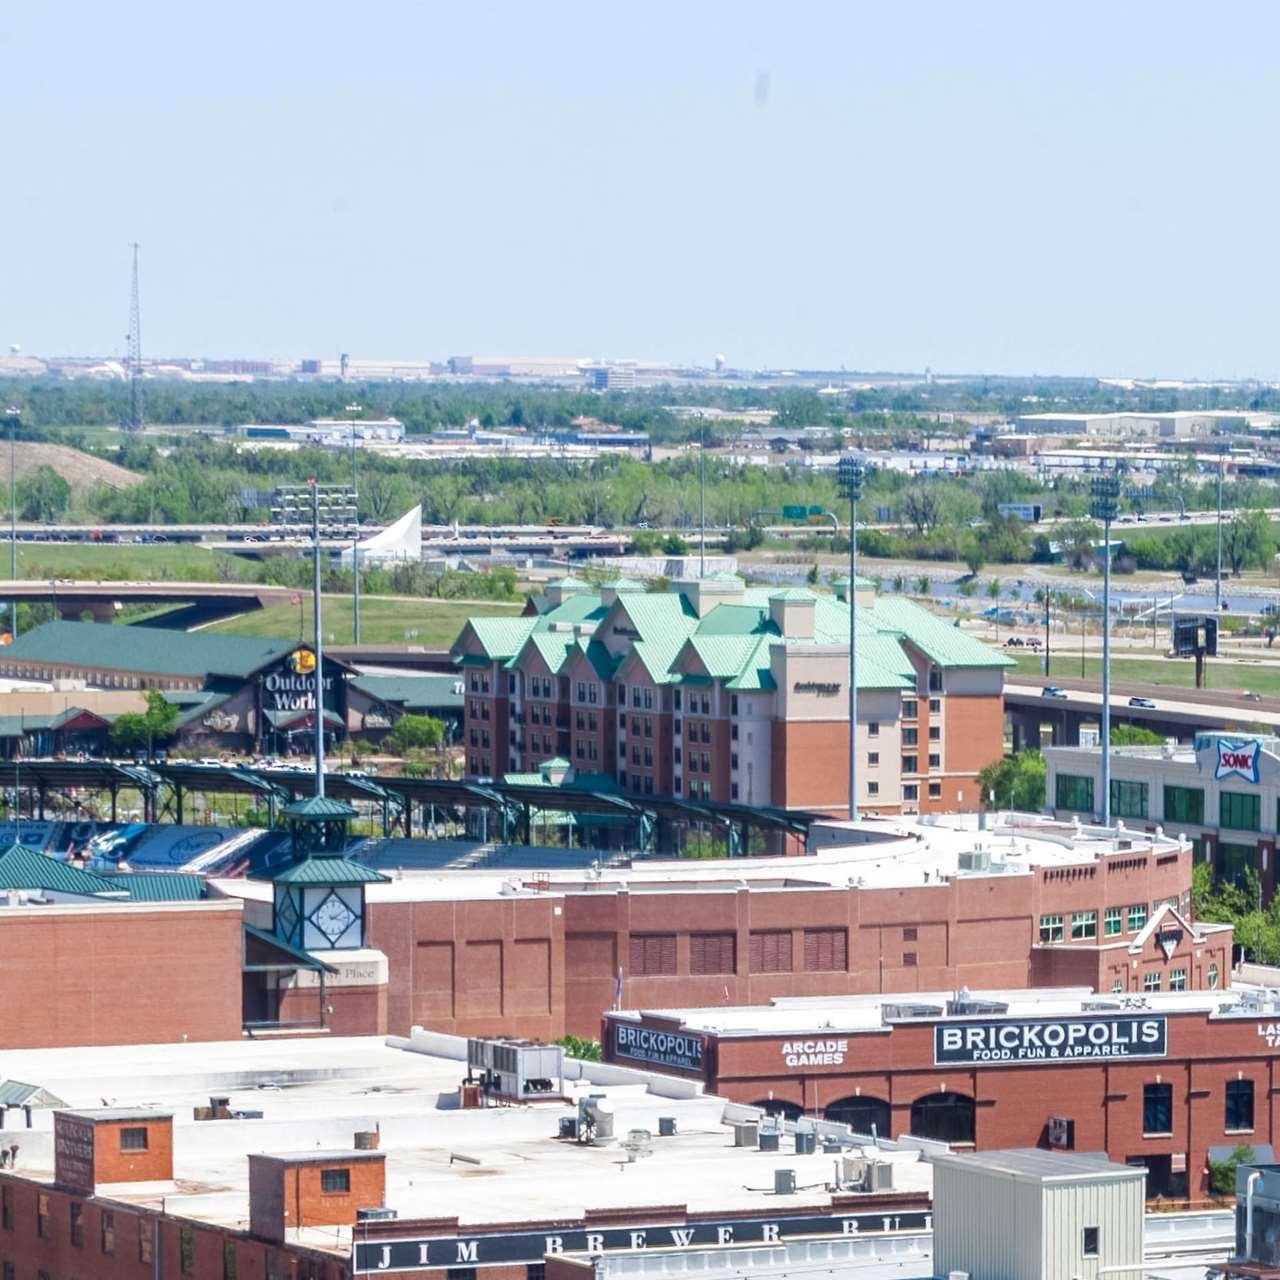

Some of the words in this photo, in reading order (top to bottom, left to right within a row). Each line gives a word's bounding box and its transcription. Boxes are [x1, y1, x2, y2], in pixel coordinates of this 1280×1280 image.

[1221, 752, 1252, 769] SONIC
[942, 1021, 1159, 1050] BRICKOPOLIS
[782, 1040, 848, 1054] ARCADE
[973, 1050, 1014, 1061] FOOD,
[1018, 1048, 1046, 1058] FUN
[1050, 1047, 1059, 1057] &
[1064, 1045, 1129, 1057] APPAREL
[785, 1053, 844, 1066] GAMES
[377, 1240, 480, 1269] JIM
[544, 1223, 781, 1254] BREWER
